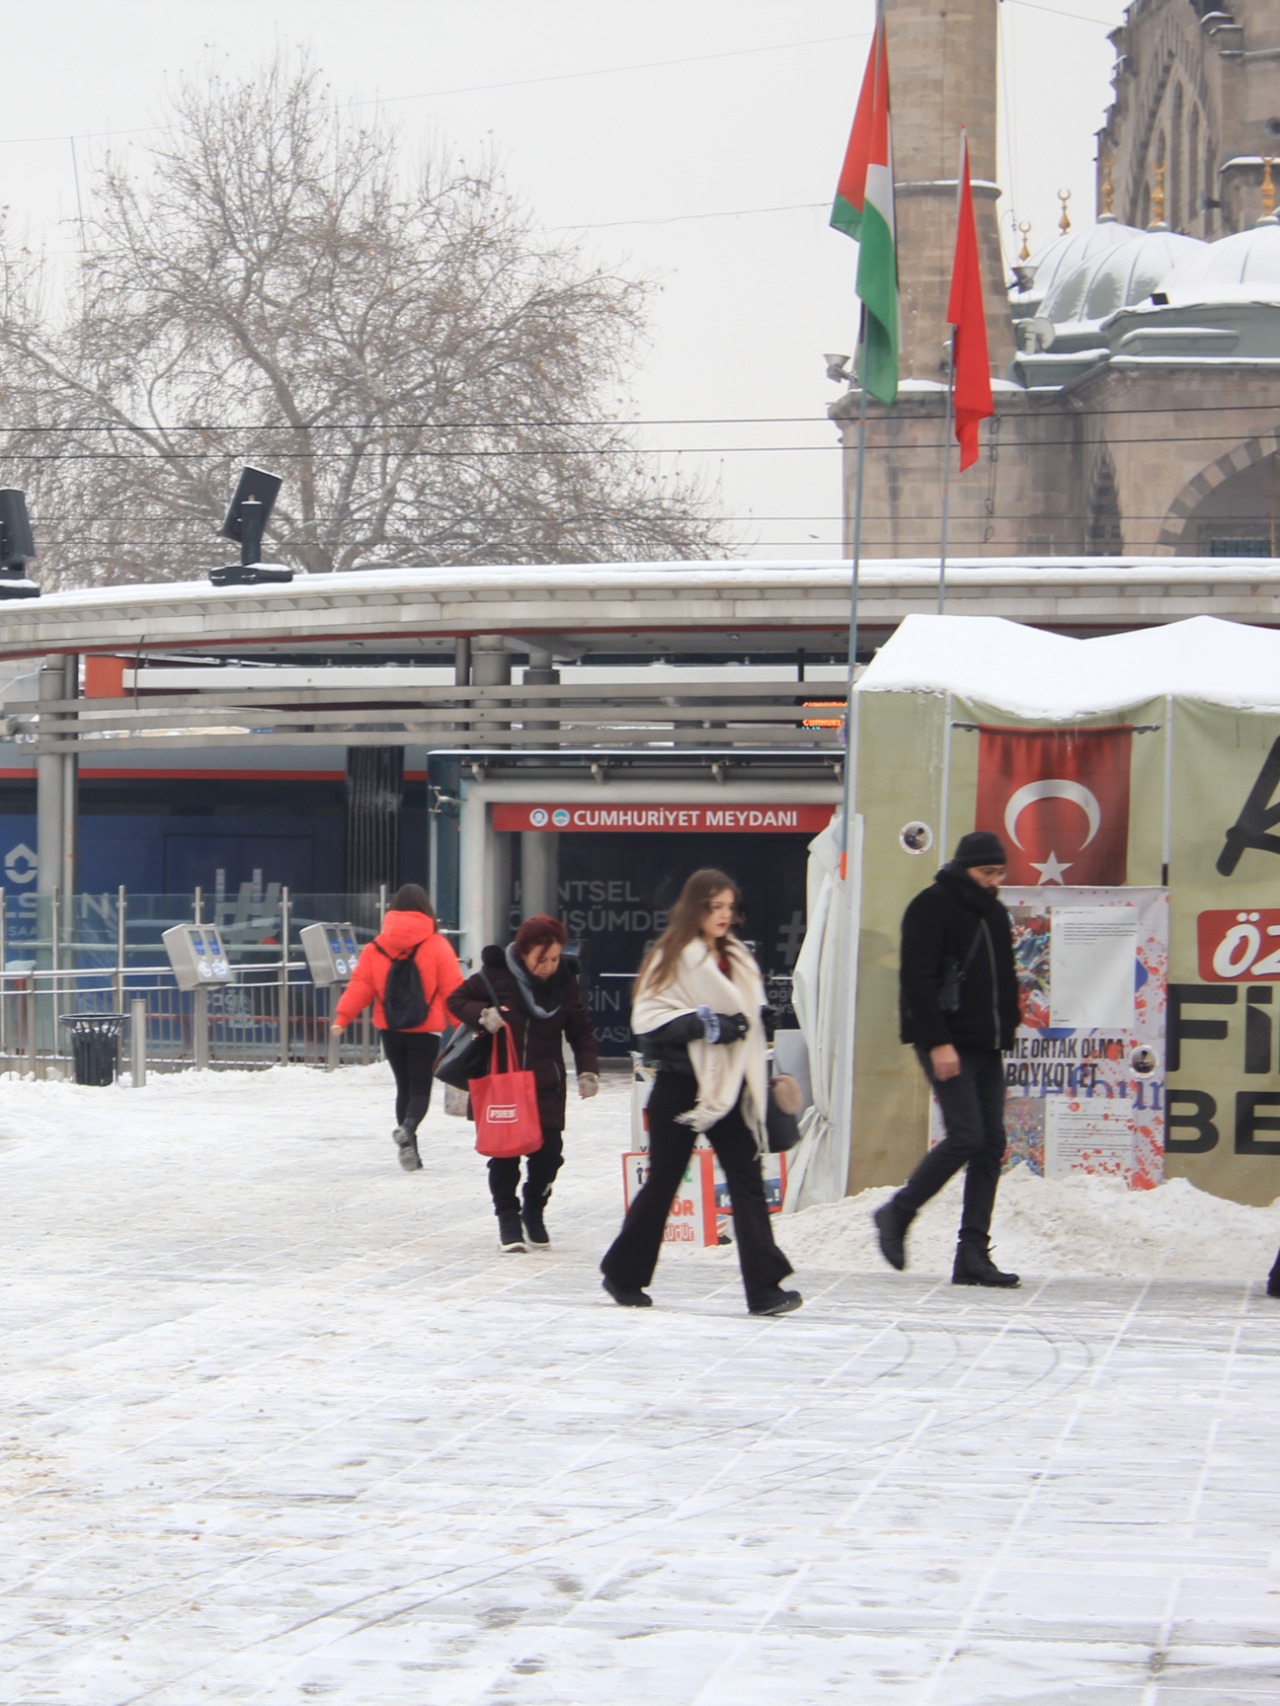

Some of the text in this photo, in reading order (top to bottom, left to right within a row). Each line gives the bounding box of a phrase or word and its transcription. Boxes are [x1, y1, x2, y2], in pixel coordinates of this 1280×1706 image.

[573, 807, 797, 827] CUMHURİYET MEYDANI
[514, 880, 641, 902] KNTSEL
[1030, 1038, 1078, 1059] ORTAK
[1081, 1039, 1125, 1060] OLMA
[1006, 1062, 1076, 1088] BOYKOT
